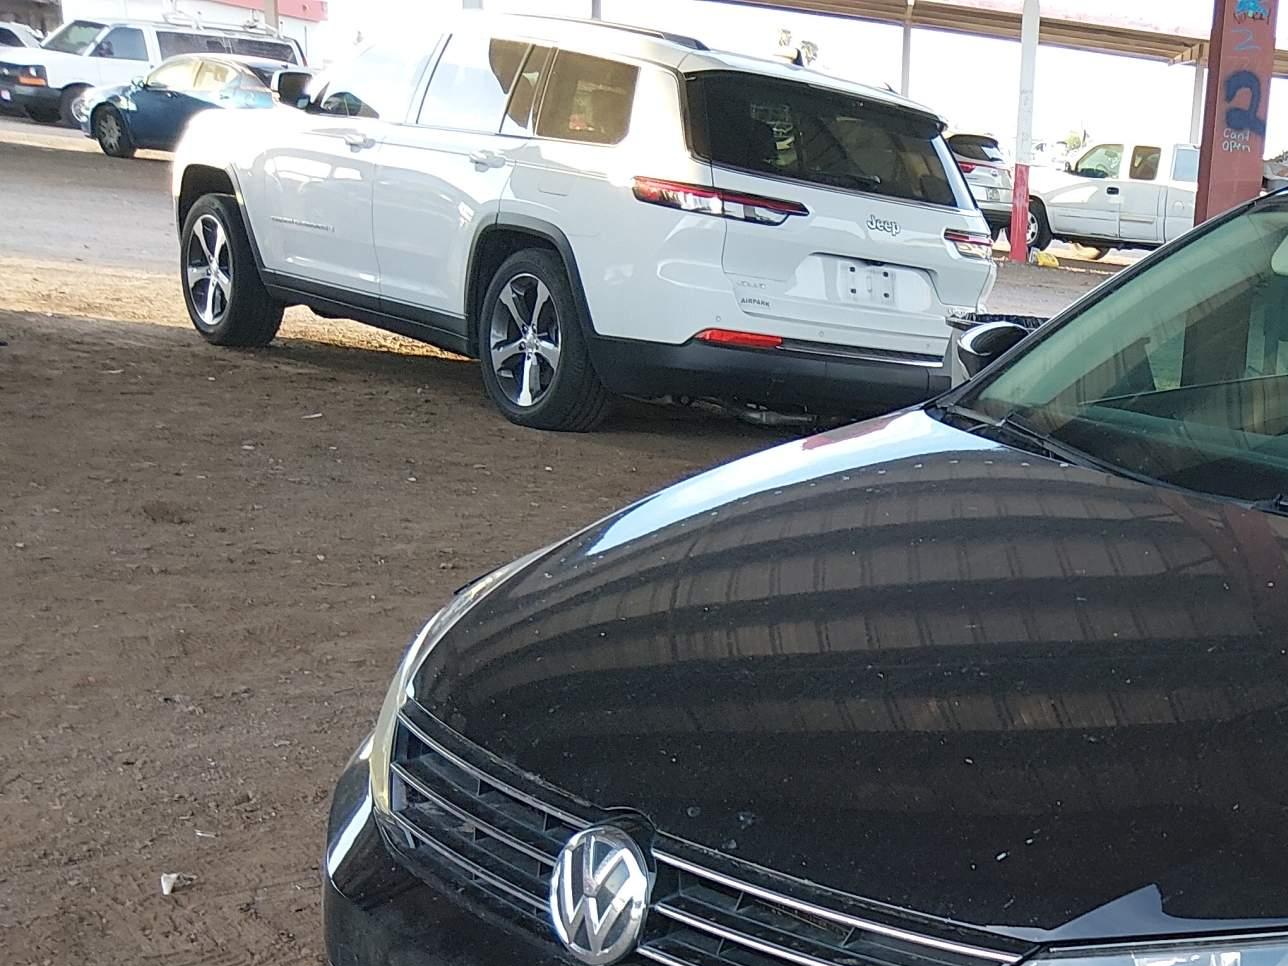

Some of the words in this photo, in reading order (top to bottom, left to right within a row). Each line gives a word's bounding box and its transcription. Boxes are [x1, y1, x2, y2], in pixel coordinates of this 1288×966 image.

[1224, 70, 1266, 136] 2
[866, 214, 901, 237] Jeep
[555, 829, 649, 960] VW
